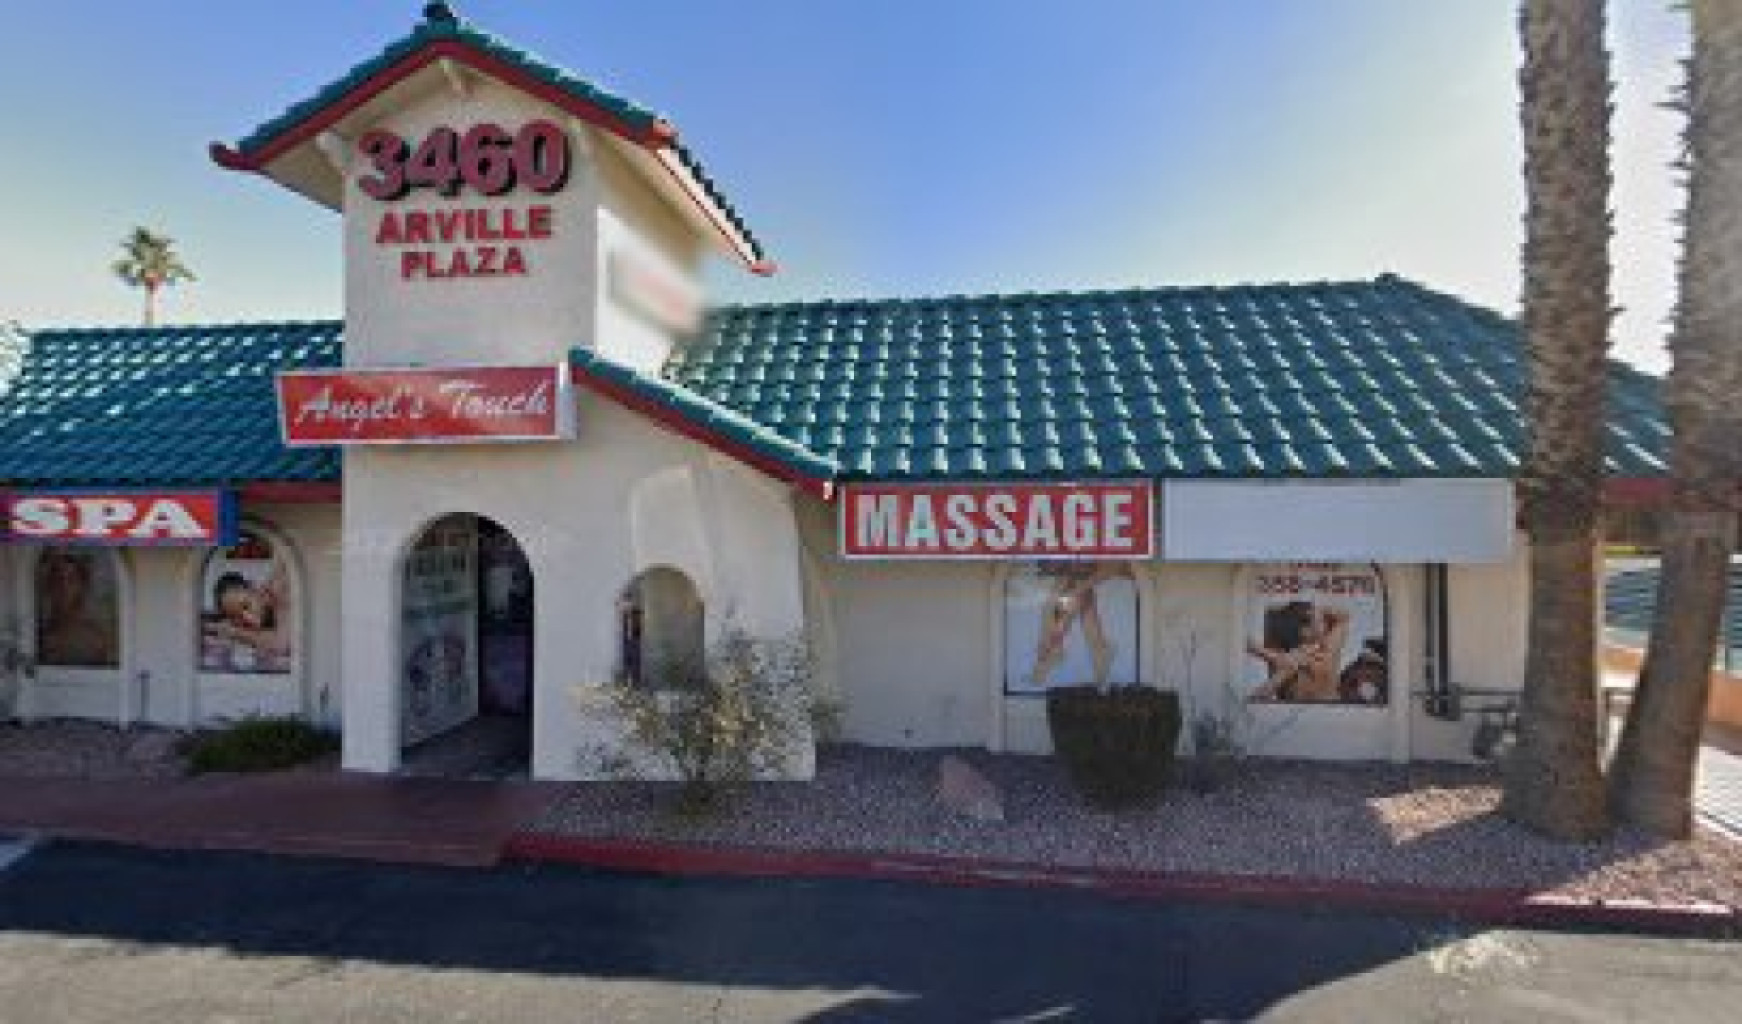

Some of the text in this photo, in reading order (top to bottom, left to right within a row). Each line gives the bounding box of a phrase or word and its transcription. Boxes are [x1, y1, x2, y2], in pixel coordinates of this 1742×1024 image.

[358, 119, 569, 201] 3460
[376, 205, 554, 244] ARVILLE
[401, 246, 526, 279] PLAZA
[293, 379, 548, 431] Angel's Touch
[10, 498, 210, 538] SPA
[856, 493, 1132, 552] MASSAGE
